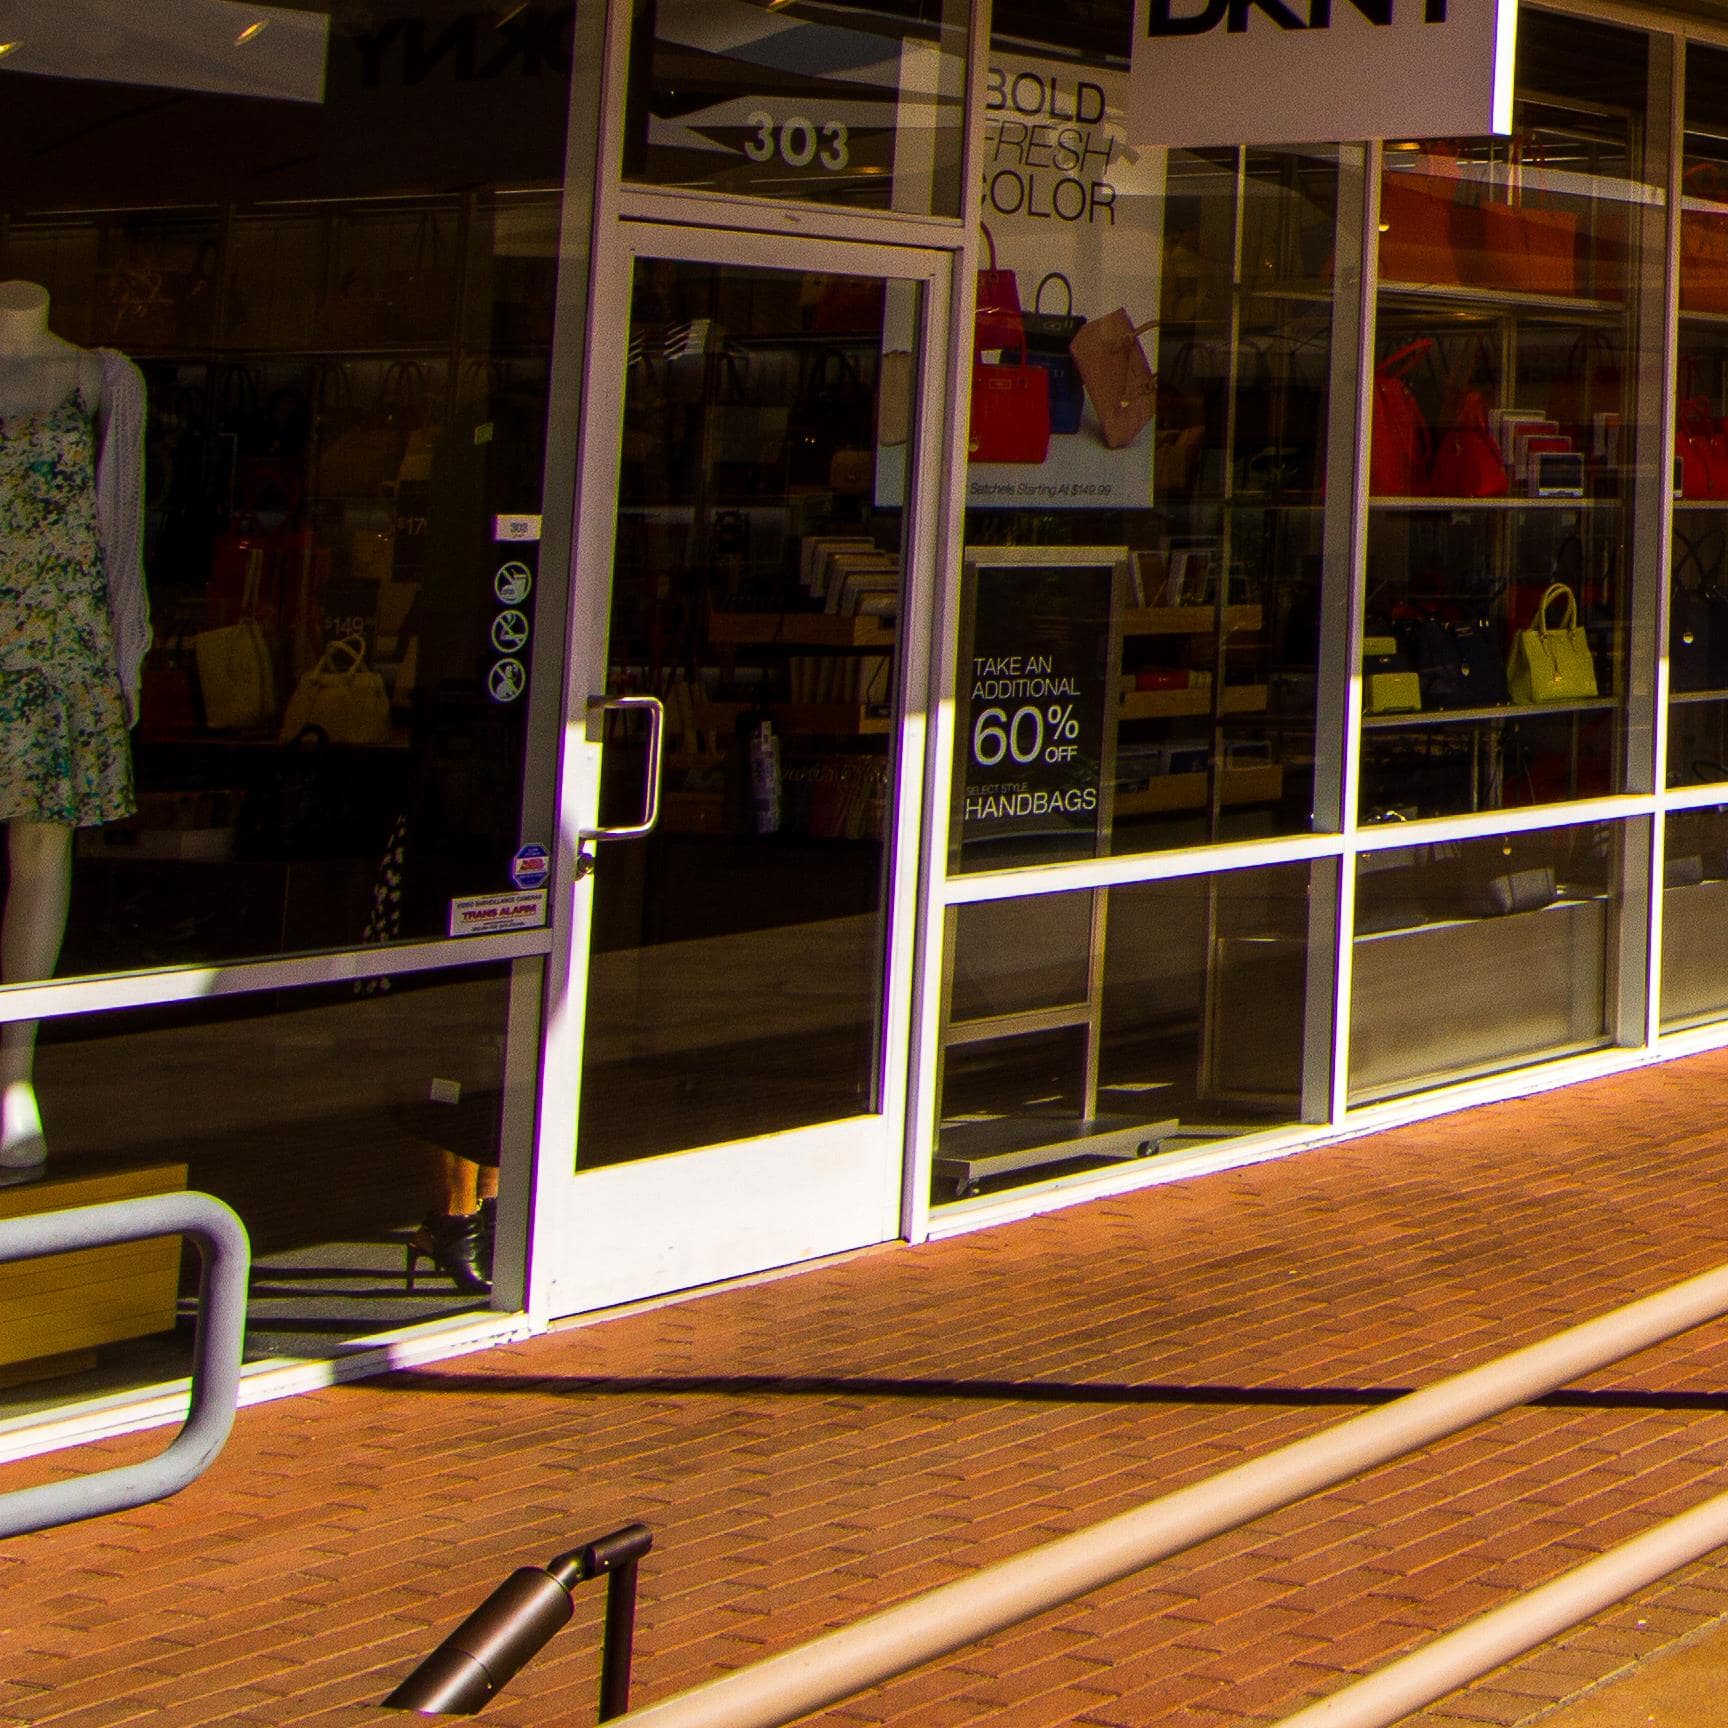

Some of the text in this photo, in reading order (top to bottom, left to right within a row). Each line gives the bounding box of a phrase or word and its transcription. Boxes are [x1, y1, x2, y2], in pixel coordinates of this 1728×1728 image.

[986, 68, 1106, 125] BOLD
[744, 111, 850, 171] 303
[982, 170, 1117, 226] OLOR
[970, 480, 1112, 498] Satchels Starting At $149.99
[973, 656, 1052, 676] TAKE AN
[971, 677, 1081, 700] ADDITIONAL
[973, 704, 1079, 766] 60%
[1045, 745, 1079, 763] OFF
[966, 782, 1029, 796] SELECT STYLE
[965, 788, 1098, 821] HANDBAGS
[462, 904, 537, 920] TRANS ALARM
